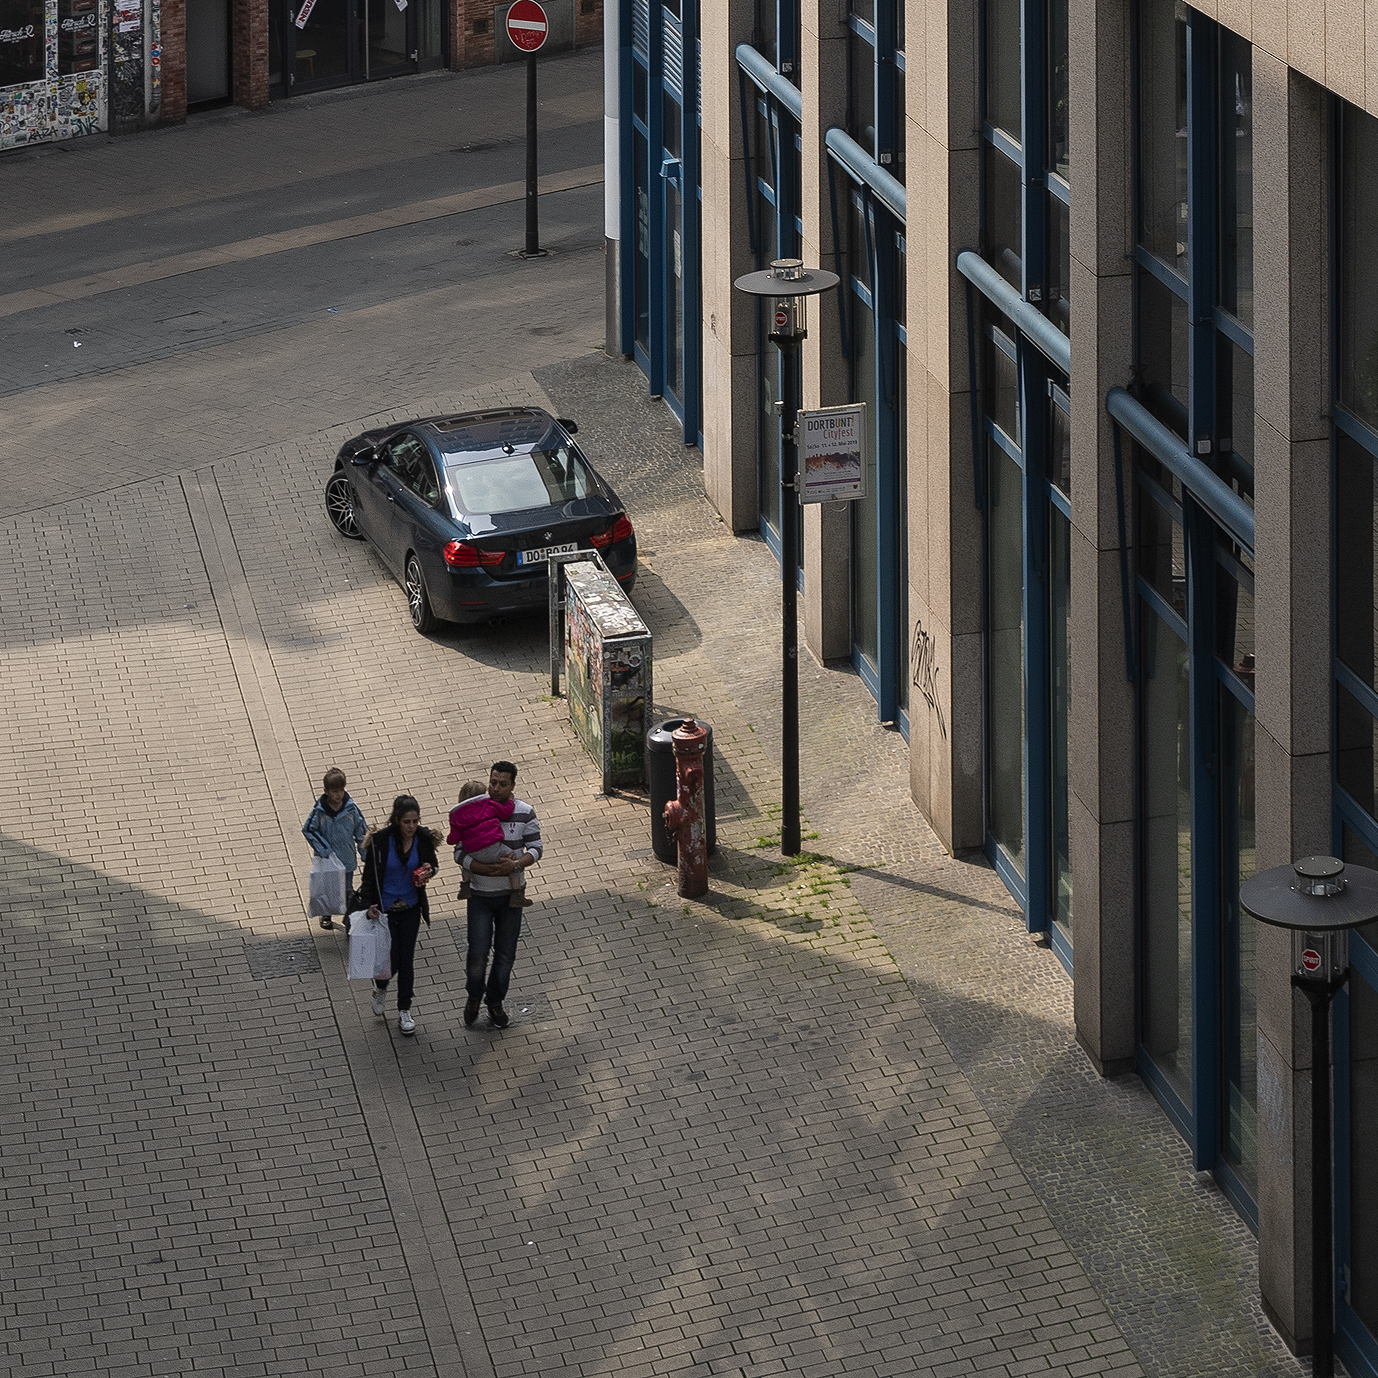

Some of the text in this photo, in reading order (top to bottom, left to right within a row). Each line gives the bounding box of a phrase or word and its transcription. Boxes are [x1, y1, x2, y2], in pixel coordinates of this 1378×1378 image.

[807, 414, 855, 432] DORTBUNT!
[823, 428, 853, 440] Cityfest
[526, 550, 540, 563] DO
